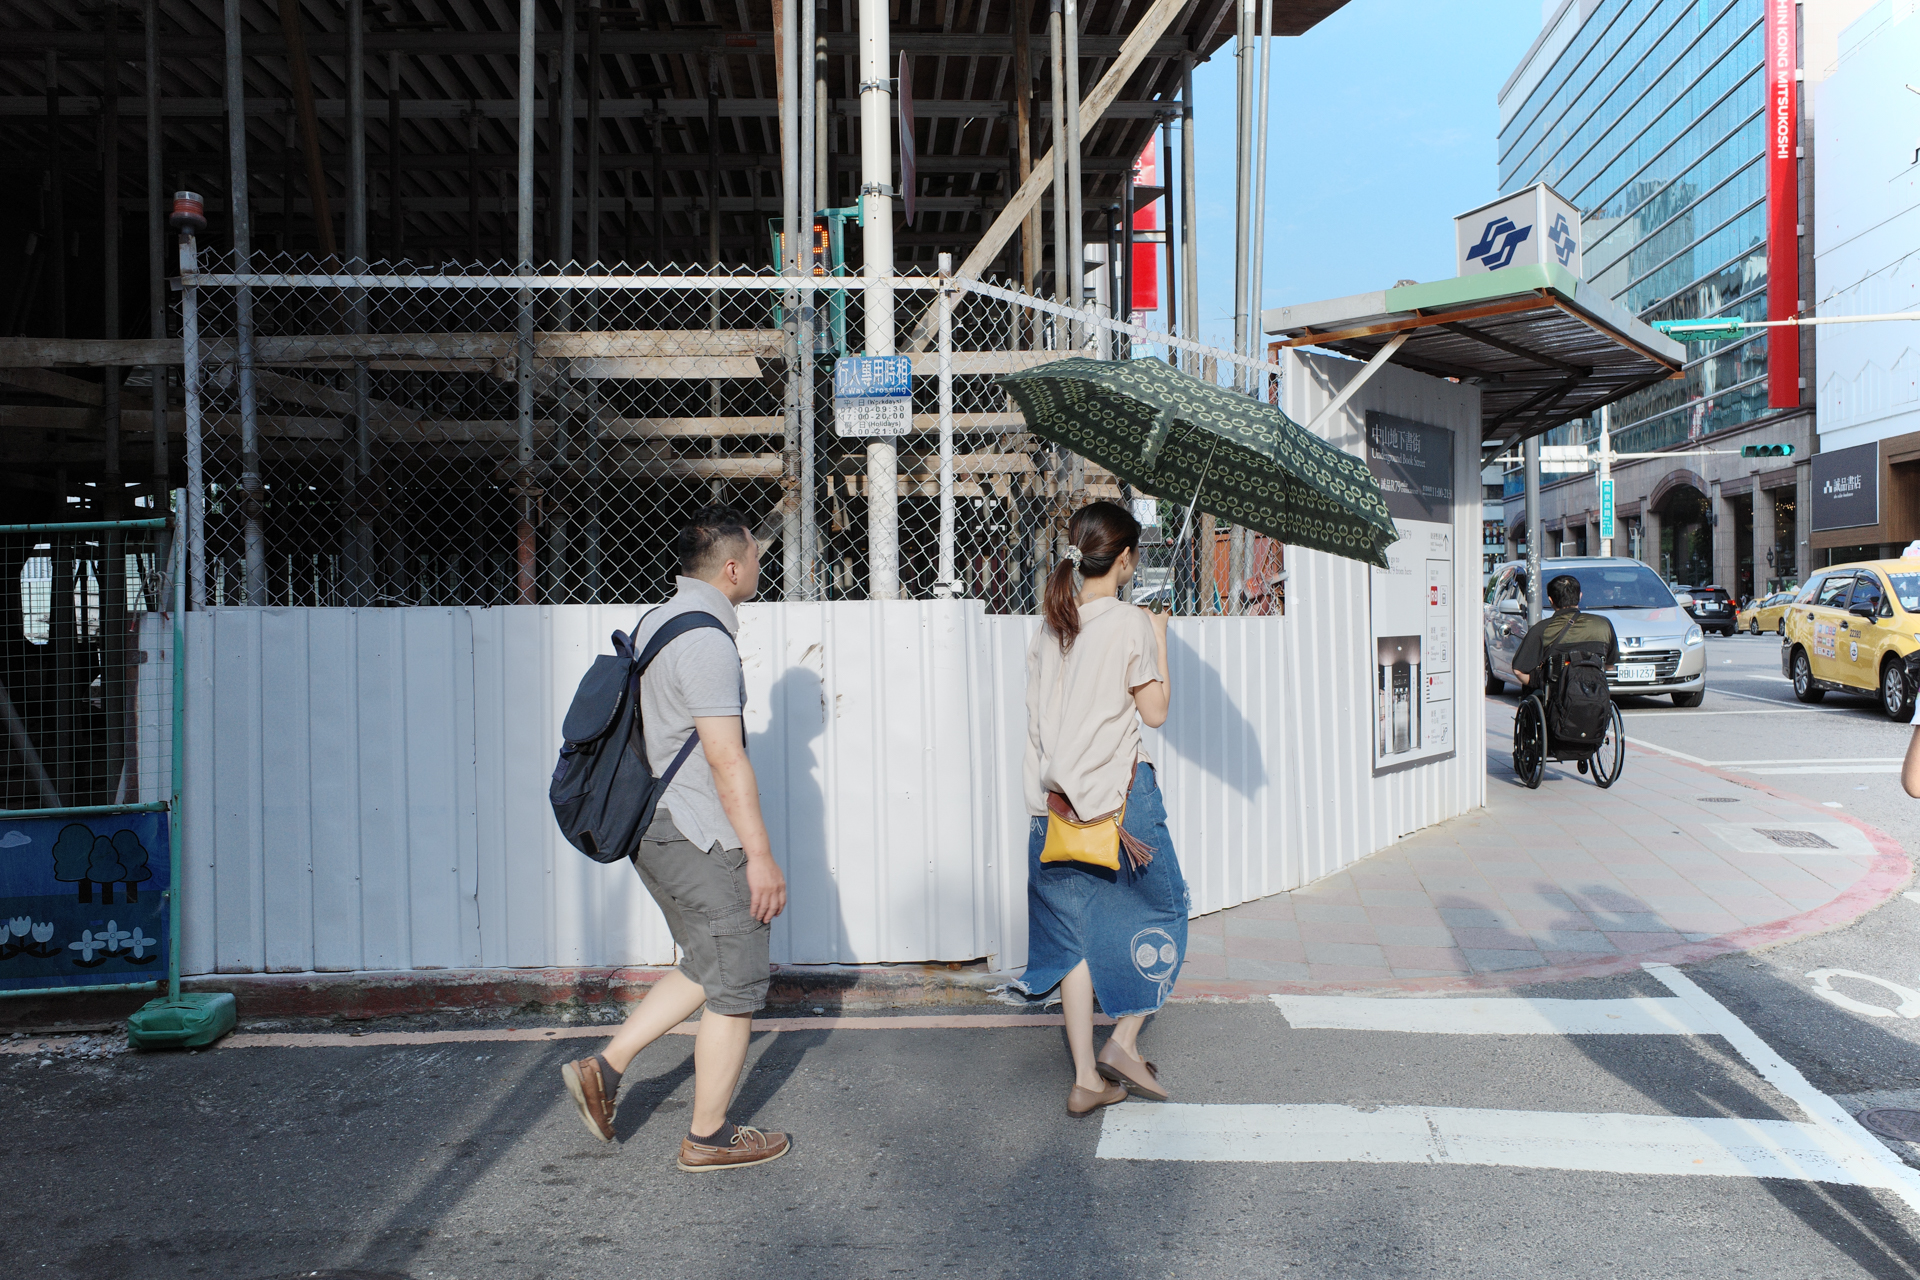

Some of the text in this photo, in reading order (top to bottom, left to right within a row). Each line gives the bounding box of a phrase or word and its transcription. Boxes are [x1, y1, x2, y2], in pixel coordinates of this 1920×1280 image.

[1777, 27, 1788, 68] KONG
[1777, 71, 1788, 159] MITSUKOSHI
[838, 359, 908, 386] 行人專用時相
[869, 387, 906, 395] Crossing
[1371, 423, 1421, 454] 中山地下書街
[1402, 453, 1414, 467] Book
